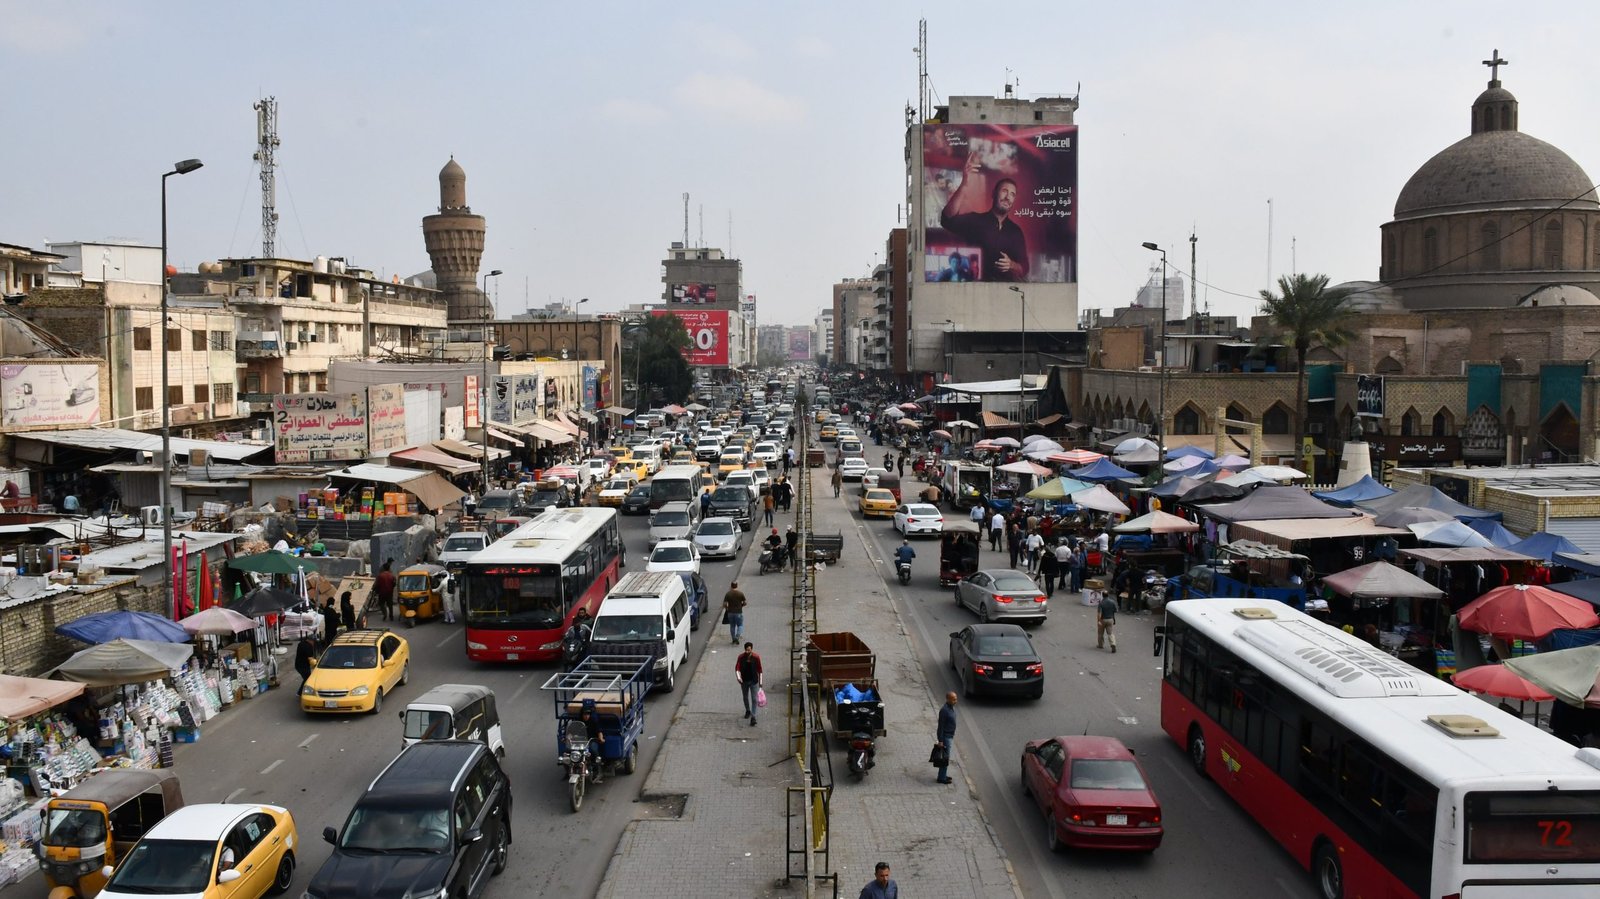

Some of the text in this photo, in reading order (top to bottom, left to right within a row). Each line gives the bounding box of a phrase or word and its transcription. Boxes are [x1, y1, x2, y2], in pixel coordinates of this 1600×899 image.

[1035, 131, 1071, 148] Asiacell
[1034, 187, 1055, 196] لبعض
[1058, 197, 1072, 207] قوة
[1036, 208, 1054, 217] نبقى
[306, 398, 337, 411] محلات
[277, 410, 288, 423] 2
[327, 413, 365, 431] مصطفى
[280, 415, 325, 435] العطواني
[1400, 442, 1446, 458] علي محسن
[1537, 820, 1572, 846] 72
